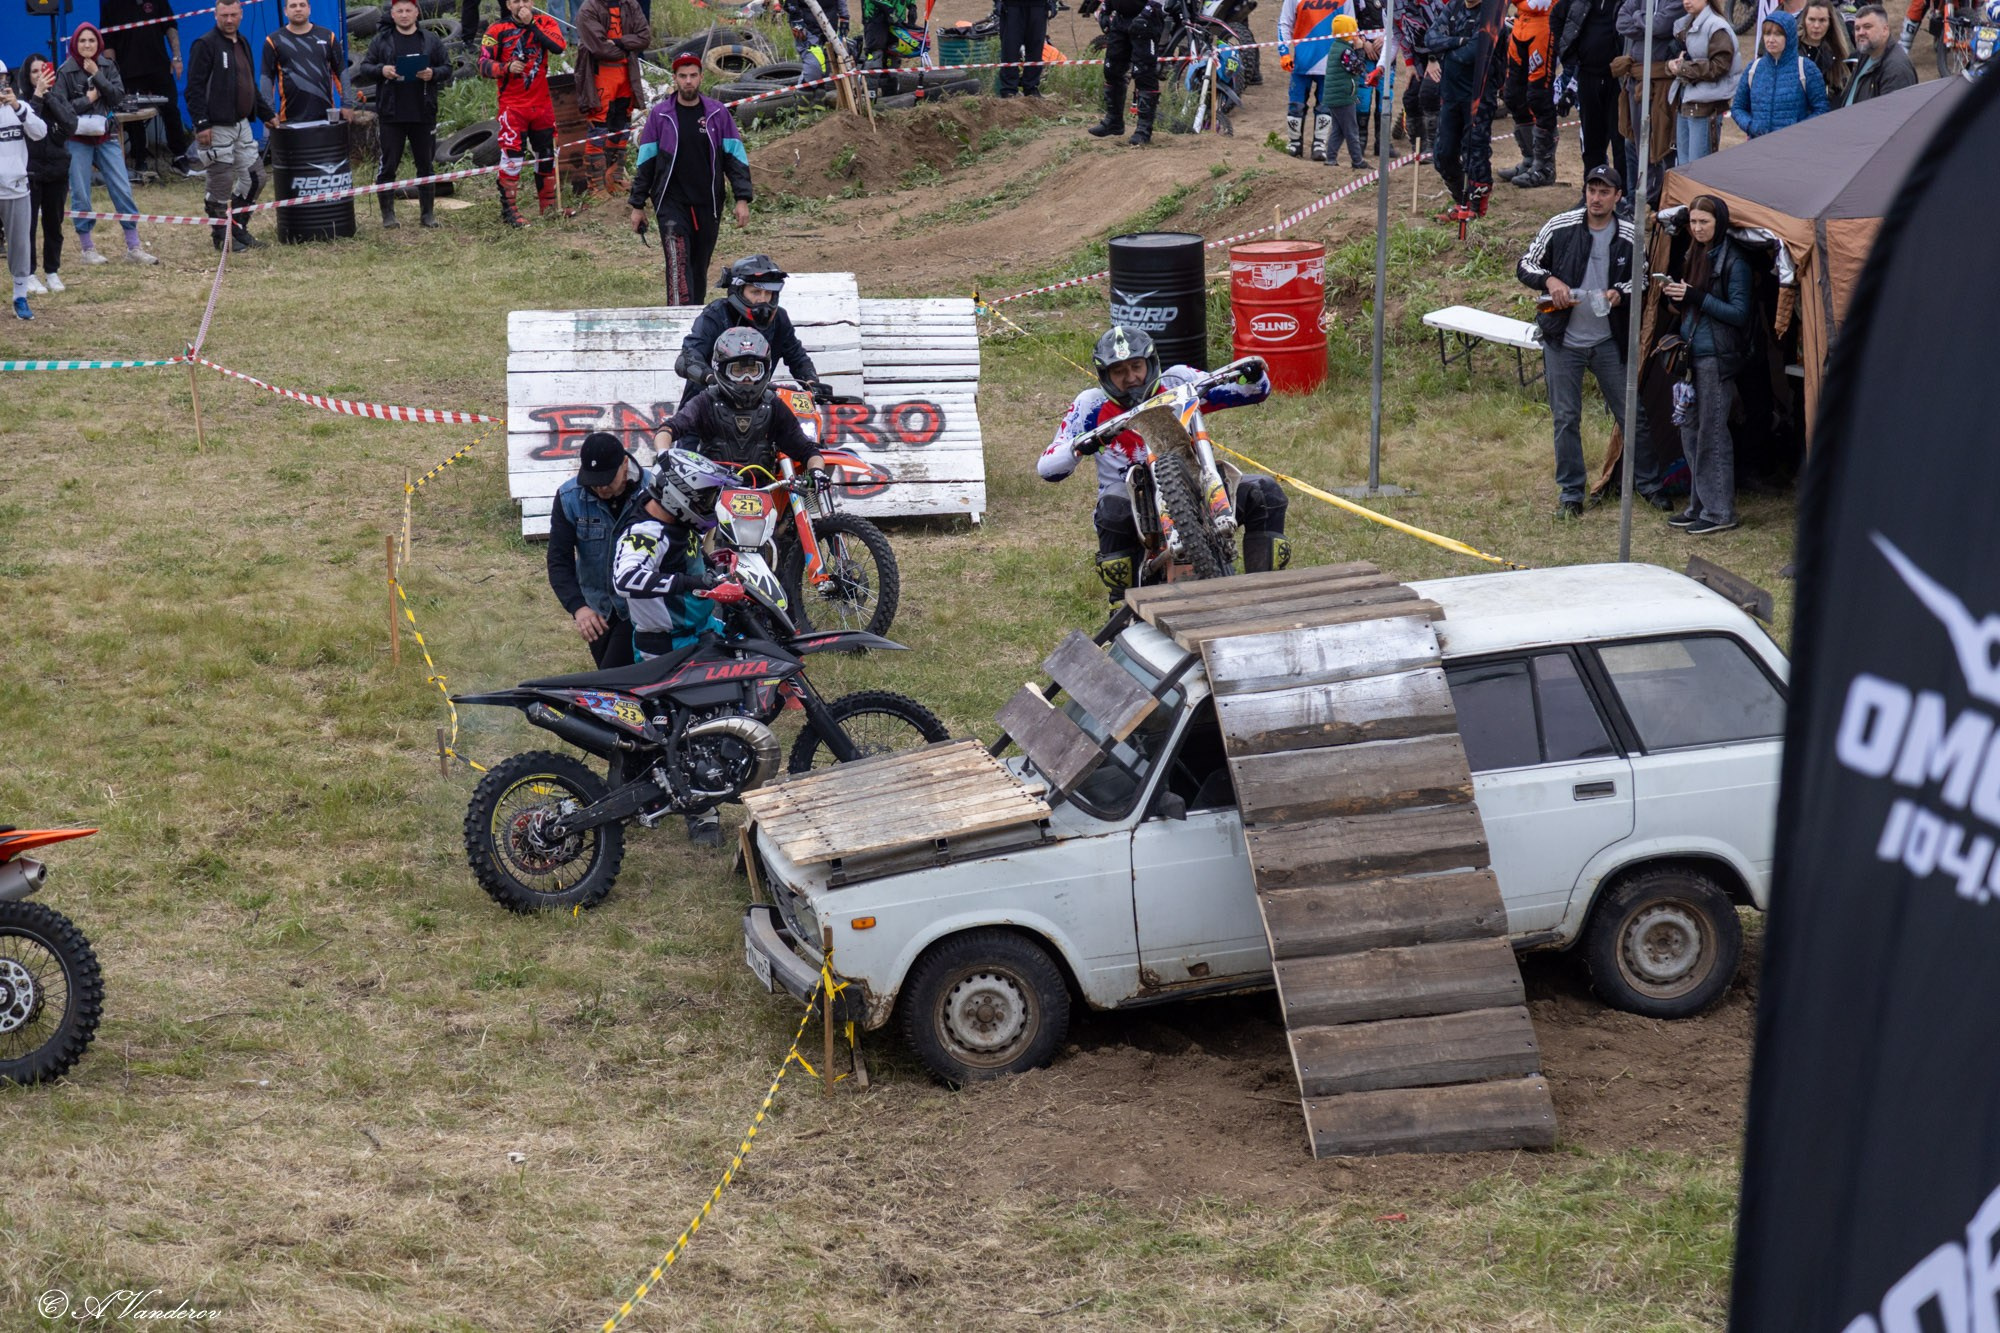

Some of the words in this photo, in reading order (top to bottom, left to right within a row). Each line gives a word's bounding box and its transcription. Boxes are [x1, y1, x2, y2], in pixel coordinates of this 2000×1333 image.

[291, 171, 353, 189] RECOR
[1110, 303, 1178, 321] ECORD
[1251, 321, 1296, 331] SINTEC
[529, 400, 946, 461] ENRO
[740, 500, 754, 511] 21
[705, 661, 769, 680] LANZA
[622, 708, 637, 721] 23
